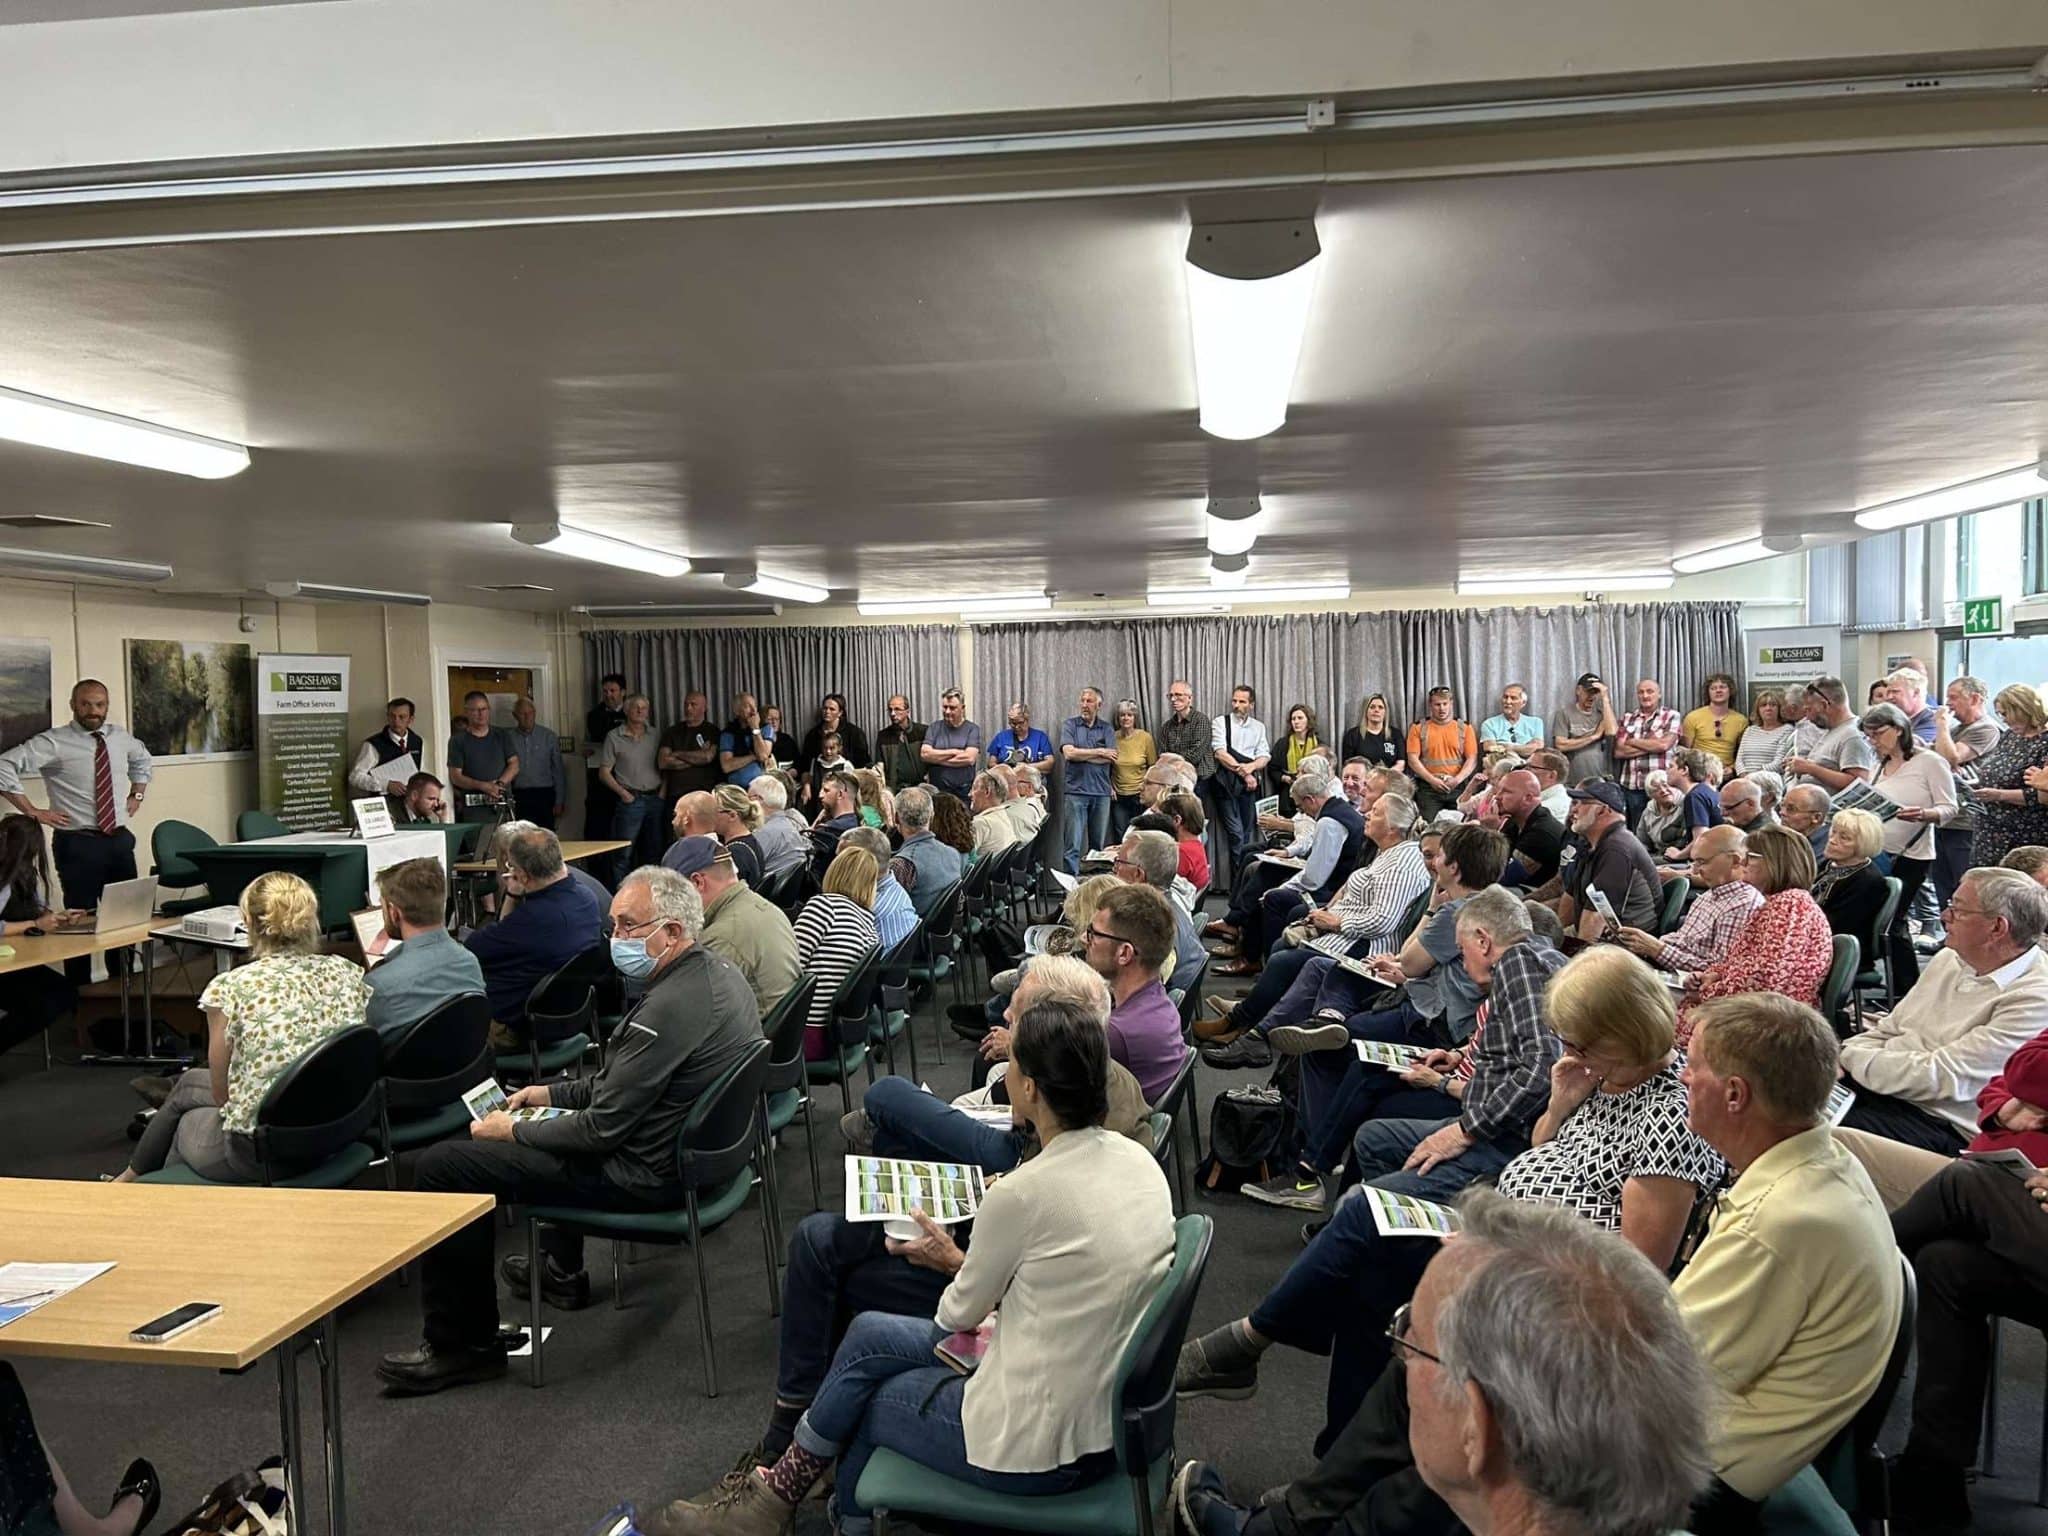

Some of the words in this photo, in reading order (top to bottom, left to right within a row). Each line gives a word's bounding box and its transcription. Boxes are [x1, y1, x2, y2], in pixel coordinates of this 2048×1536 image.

[1775, 648, 1820, 659] BAGSHAWS
[288, 674, 338, 686] BAGSHAWS
[276, 700, 292, 708] Farm
[292, 700, 310, 708] Office
[311, 699, 336, 708] Services
